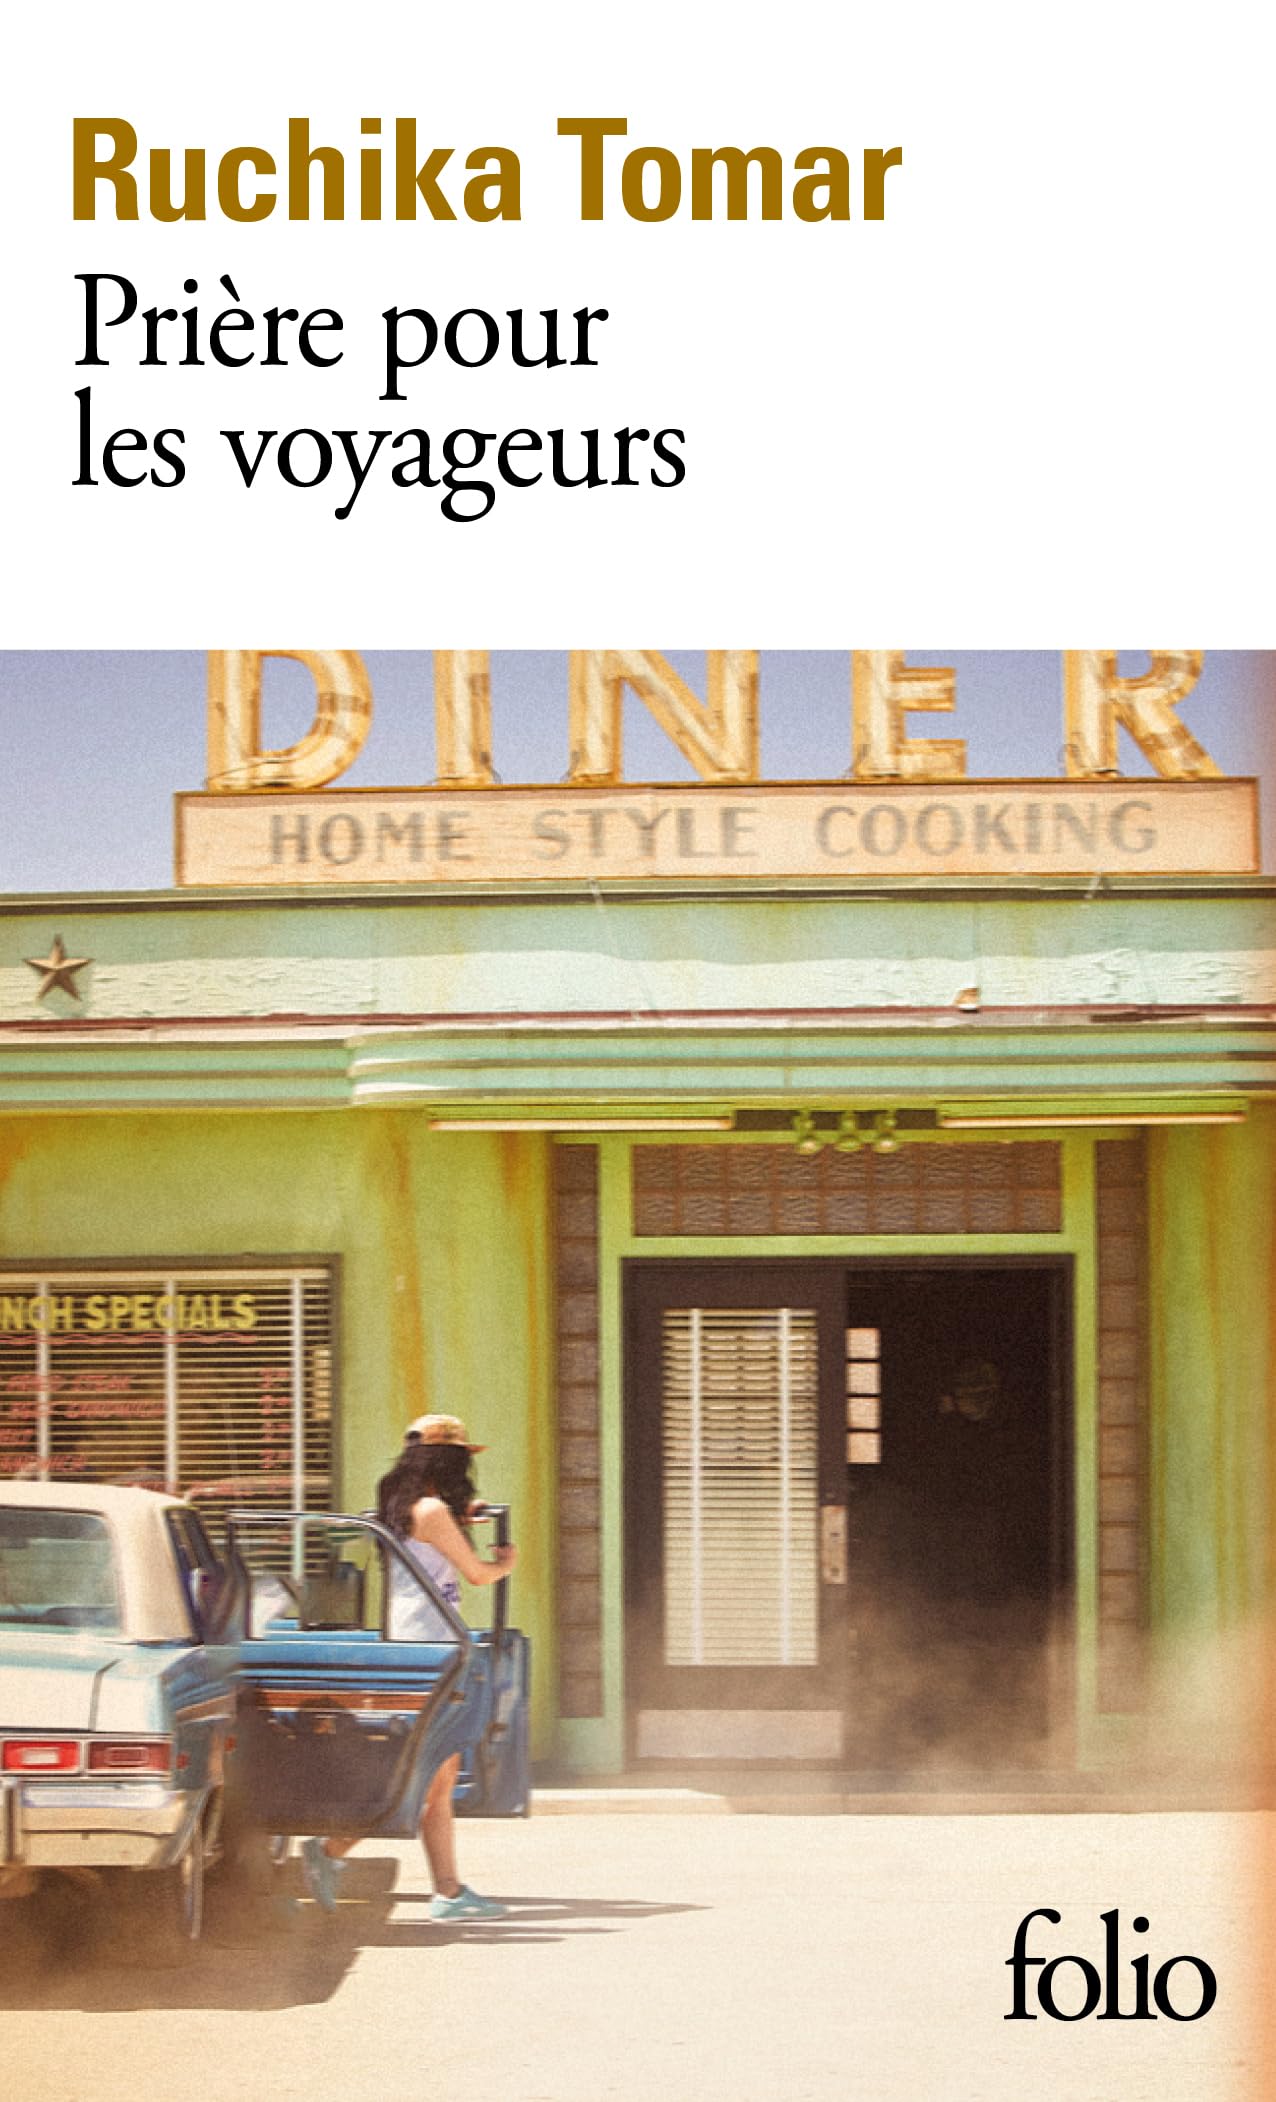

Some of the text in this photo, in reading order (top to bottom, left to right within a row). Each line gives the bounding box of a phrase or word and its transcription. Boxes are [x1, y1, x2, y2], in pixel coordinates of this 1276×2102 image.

[206, 650, 1224, 791] DINER
[269, 800, 1158, 866] HOME STYLE COOKING
[84, 1293, 257, 1330] SPECIALS
